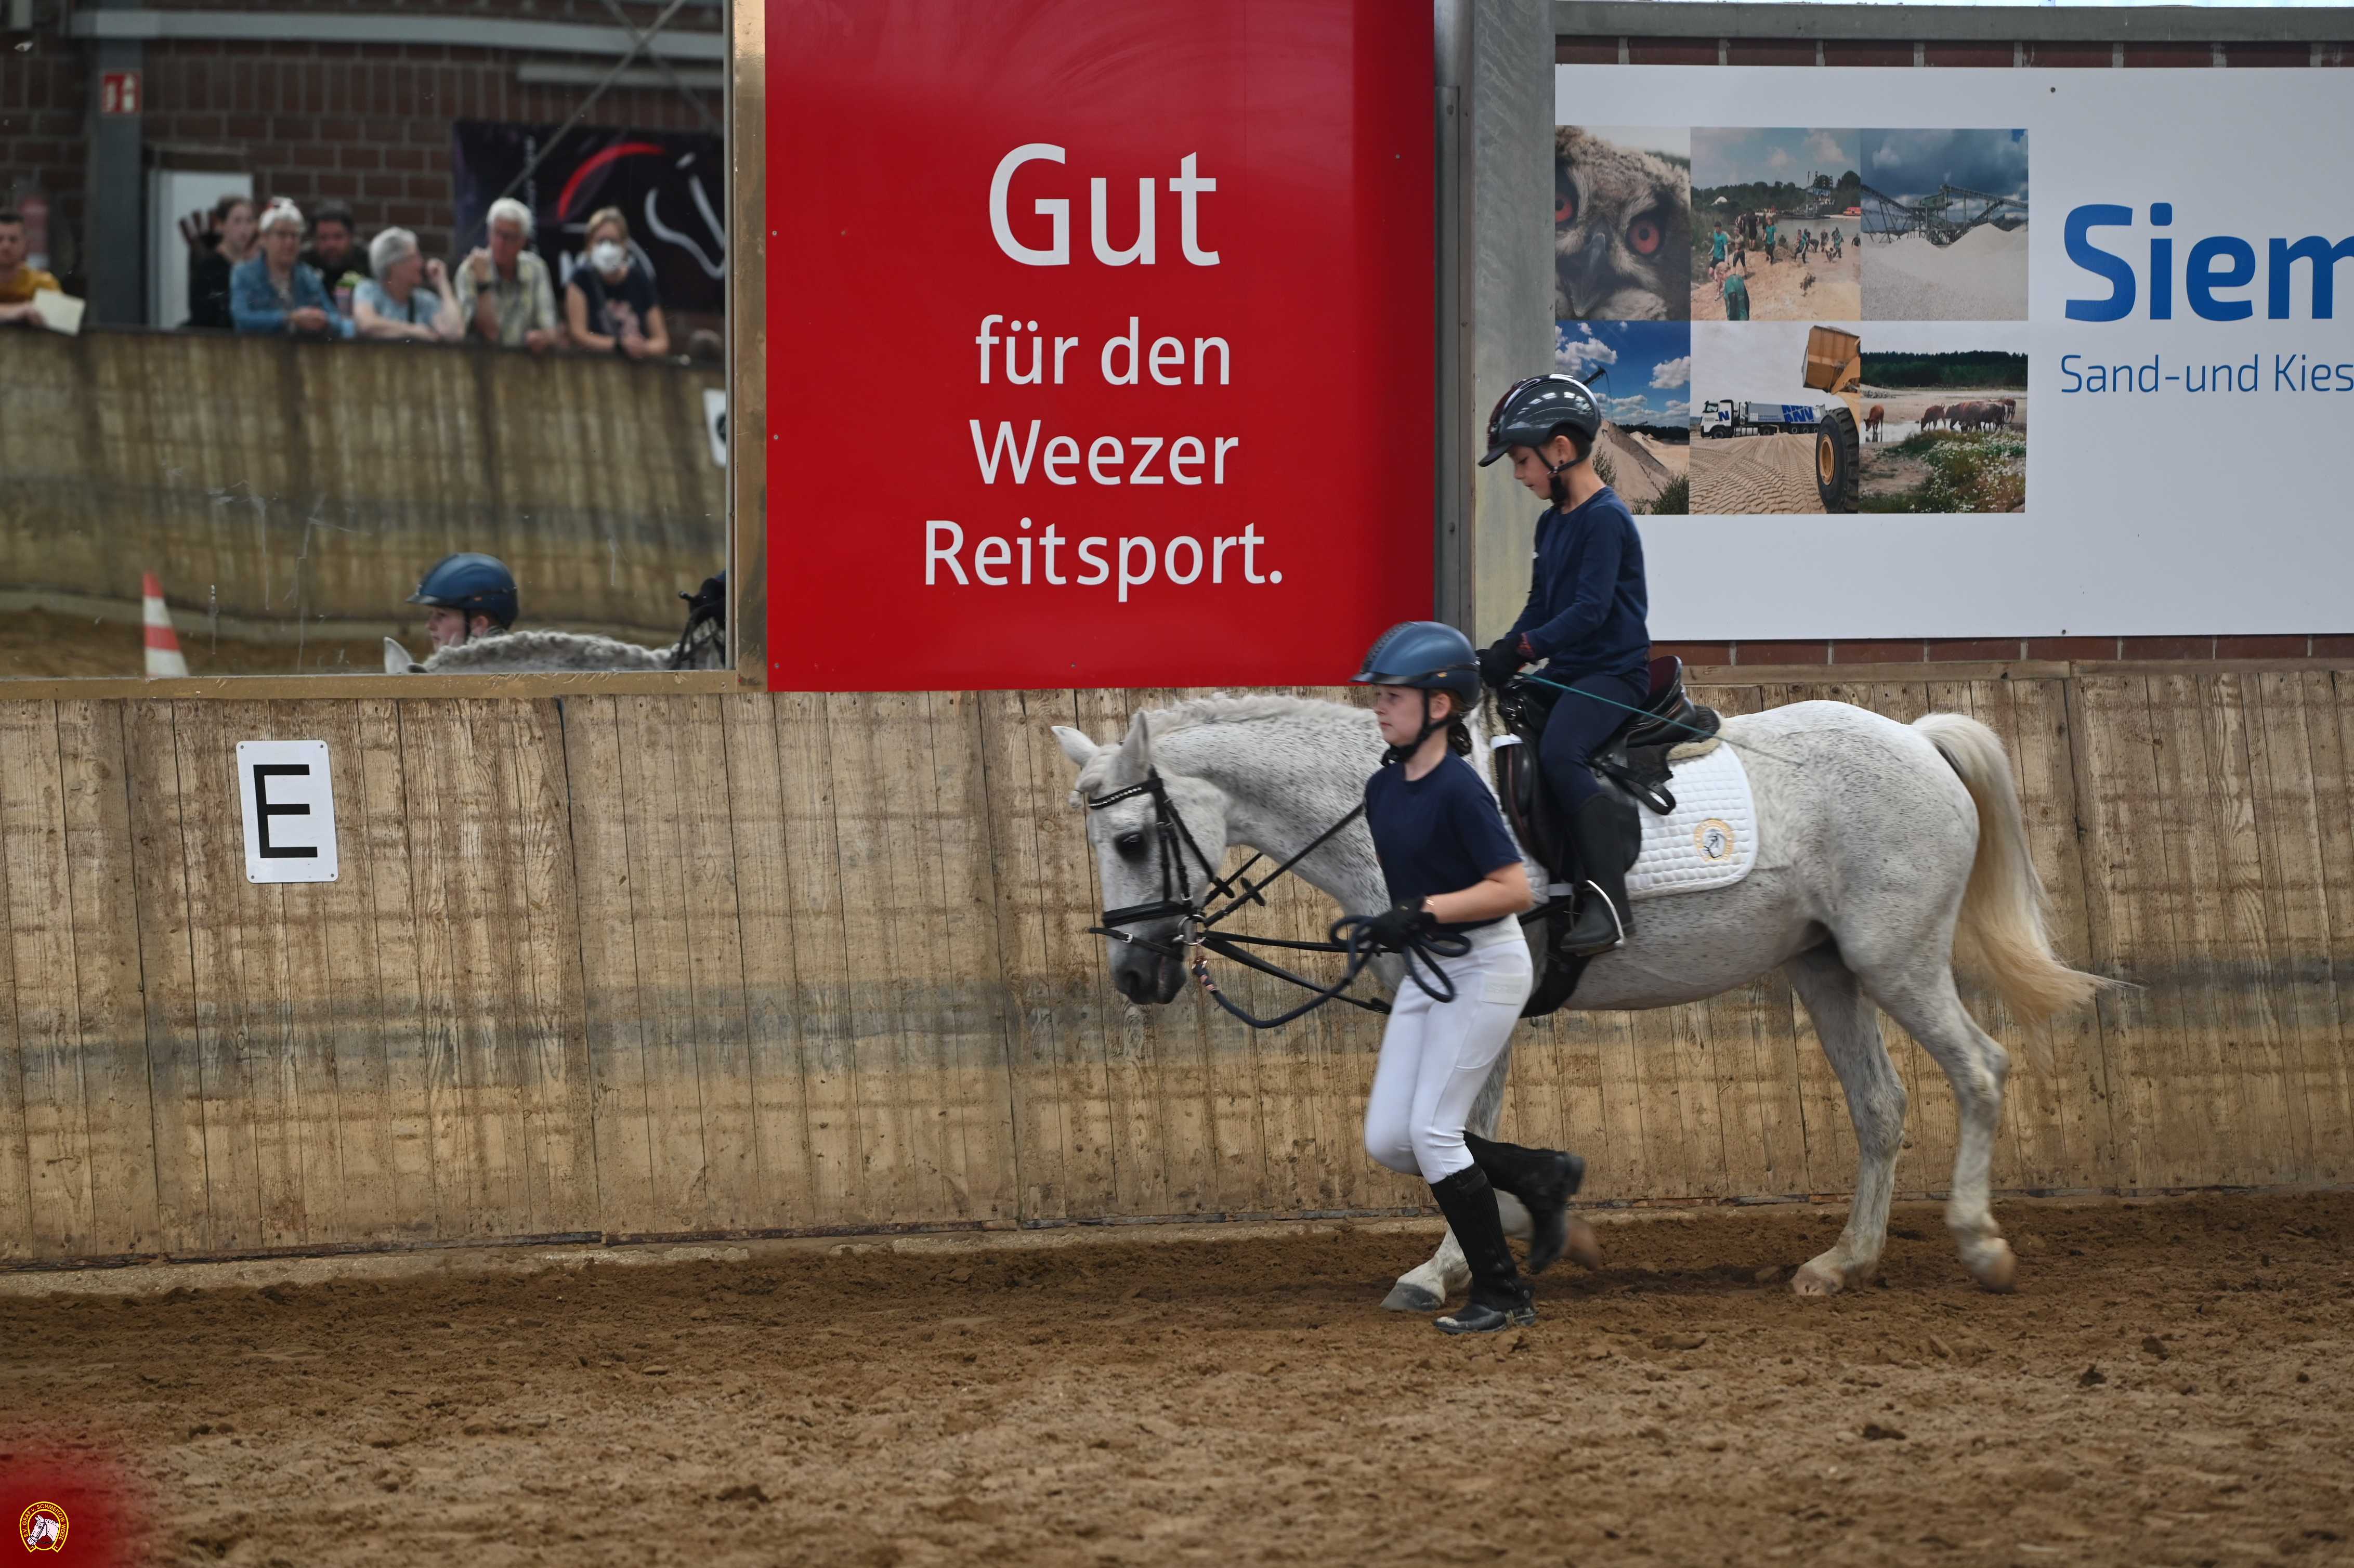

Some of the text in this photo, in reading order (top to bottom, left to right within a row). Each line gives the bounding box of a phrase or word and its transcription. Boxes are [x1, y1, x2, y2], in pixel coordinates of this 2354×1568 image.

[989, 143, 1220, 266] Gut
[2064, 201, 2354, 322] Siem
[975, 314, 1230, 386] für den
[2061, 352, 2354, 395] Sand-und Kies
[969, 419, 1239, 485] Weezer
[925, 517, 1283, 603] Reitsport.
[253, 764, 318, 858] E
